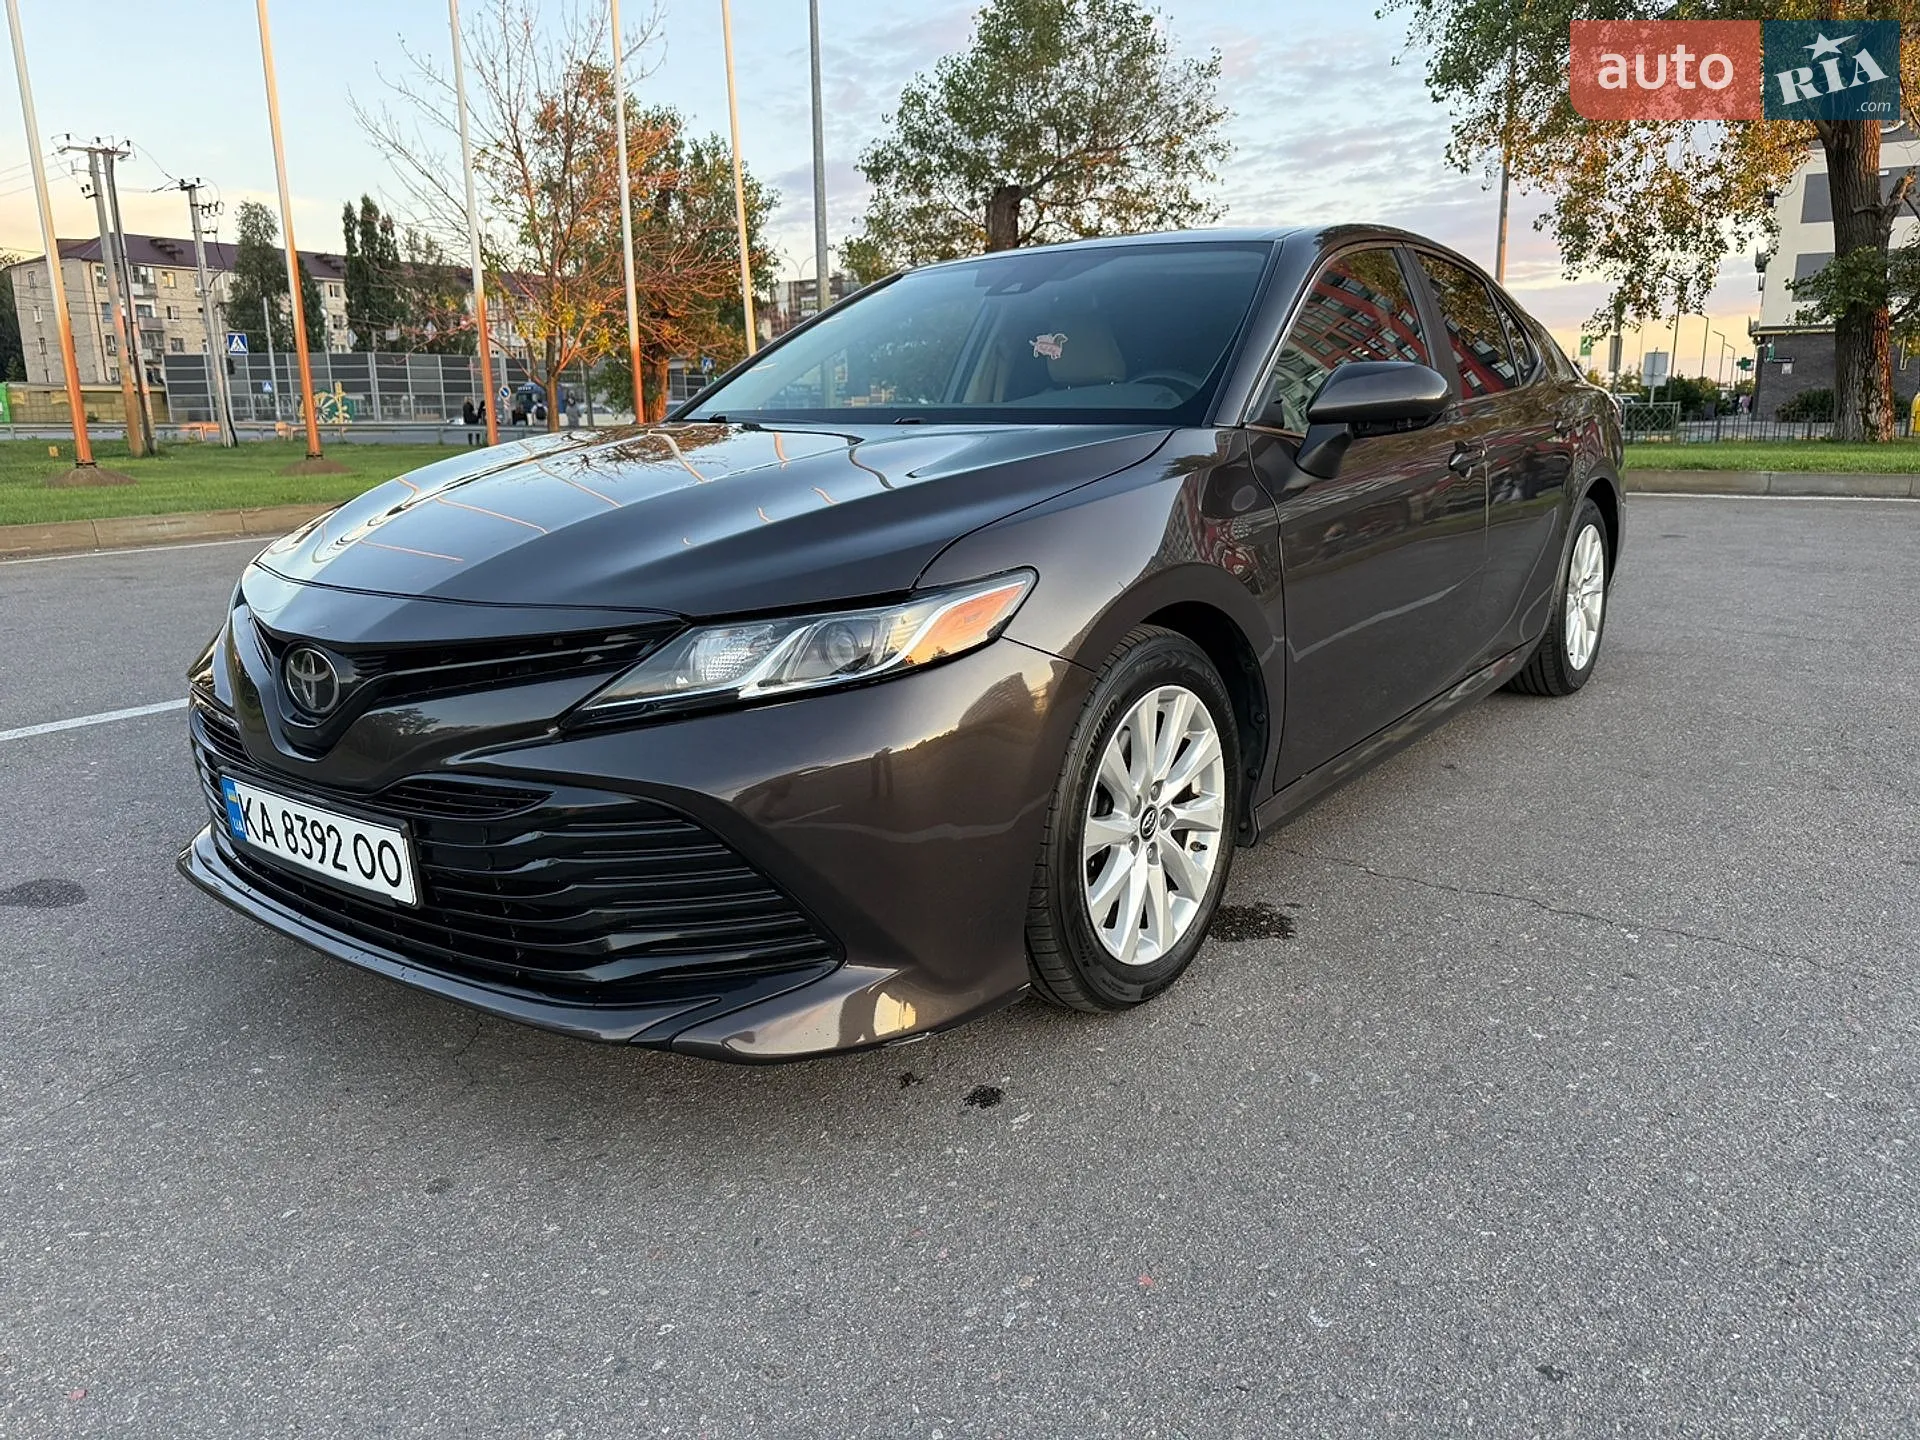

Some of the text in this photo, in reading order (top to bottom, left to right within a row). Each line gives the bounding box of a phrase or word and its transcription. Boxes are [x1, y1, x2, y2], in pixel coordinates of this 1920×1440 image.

[237, 792, 402, 888] KA 8392 OO
